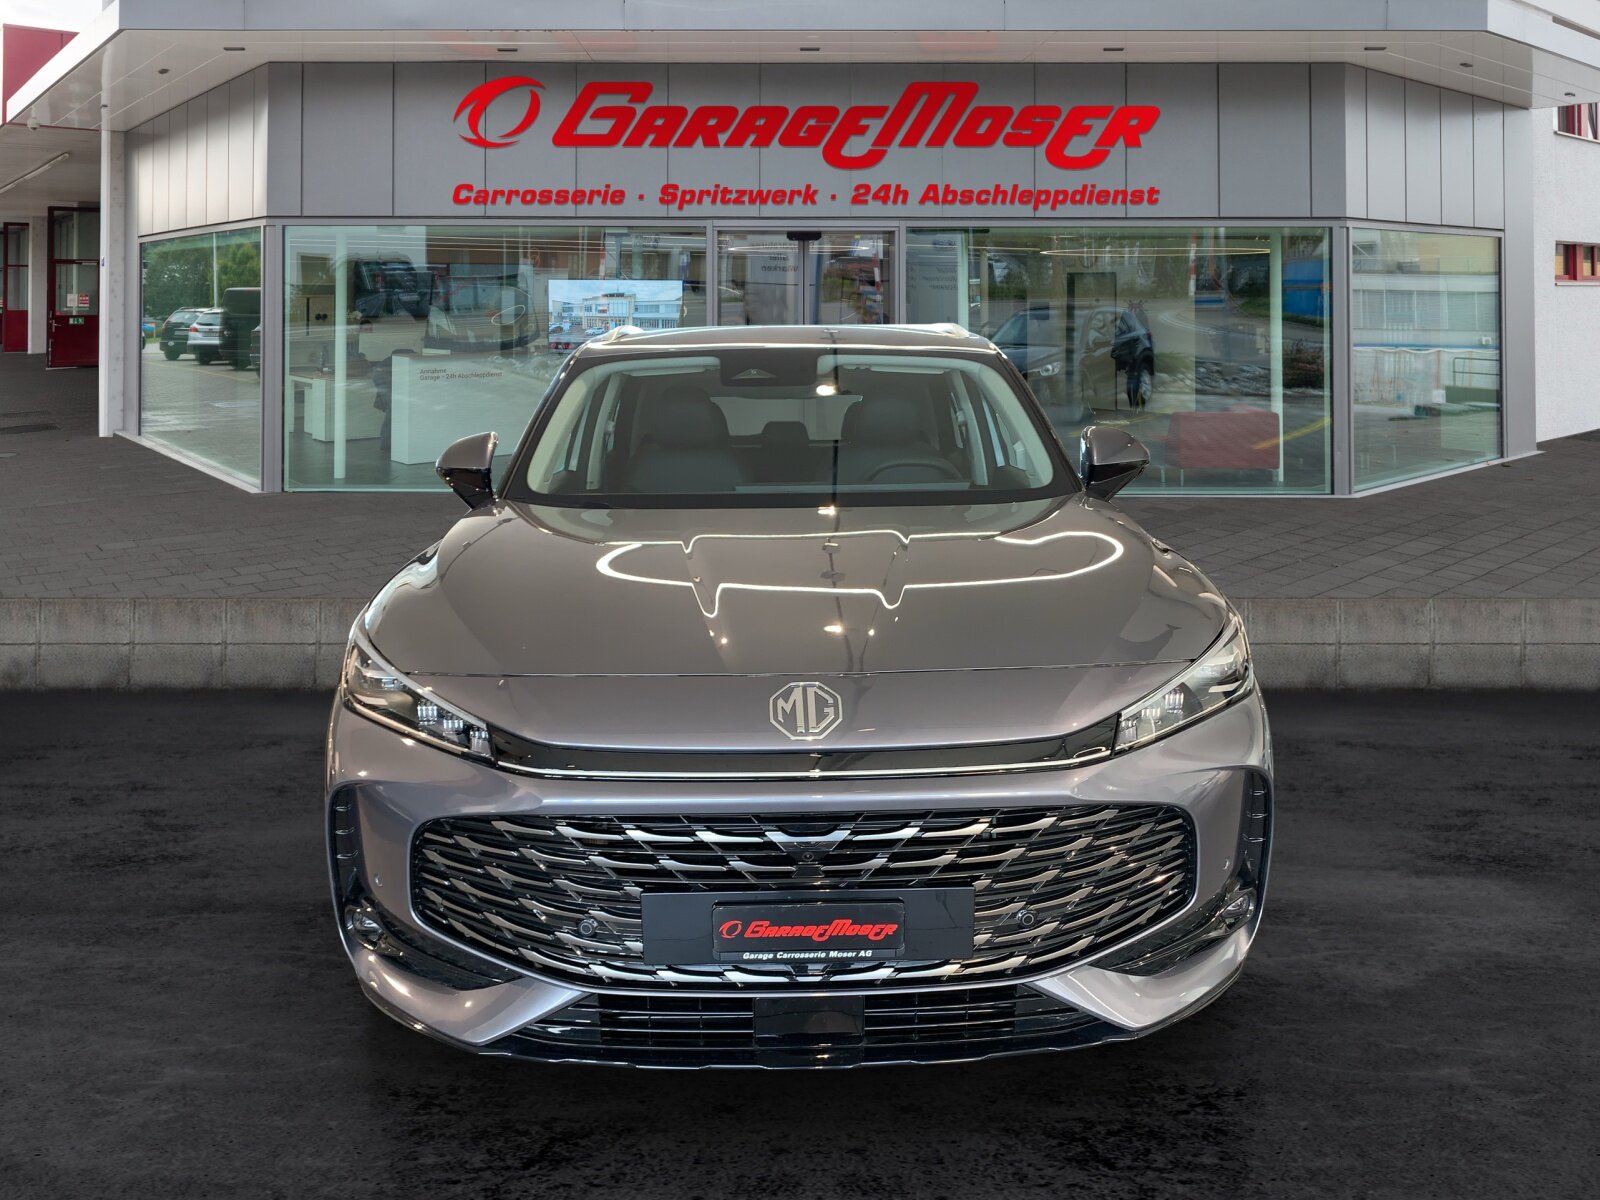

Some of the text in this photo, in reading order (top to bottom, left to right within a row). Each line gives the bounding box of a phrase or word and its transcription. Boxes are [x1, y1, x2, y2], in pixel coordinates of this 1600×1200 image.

[452, 182, 1161, 210] Carrosserie Spritzwerk 24h Abschleppdienst
[777, 686, 835, 733] MG
[742, 952, 774, 960] Garage
[776, 951, 826, 959] Carrosserie
[828, 950, 857, 958] Moser
